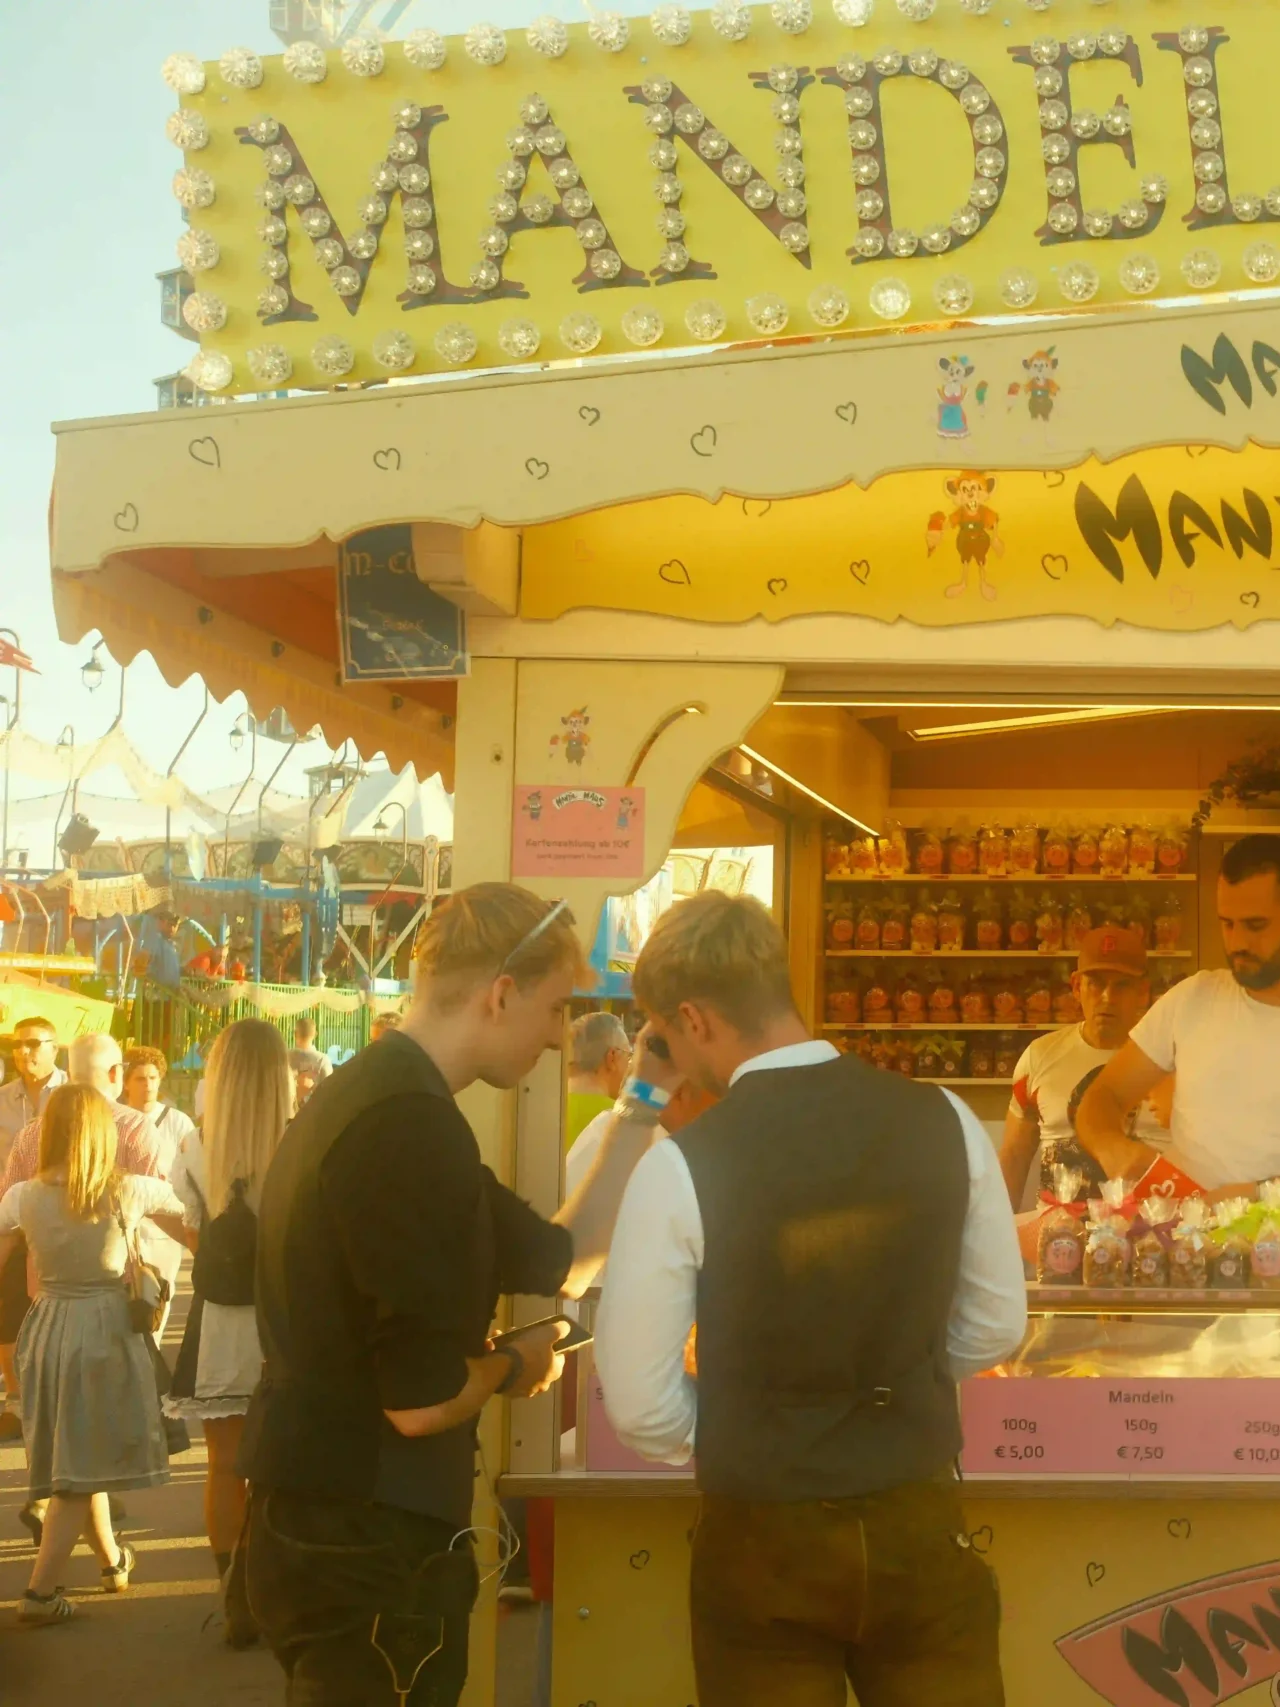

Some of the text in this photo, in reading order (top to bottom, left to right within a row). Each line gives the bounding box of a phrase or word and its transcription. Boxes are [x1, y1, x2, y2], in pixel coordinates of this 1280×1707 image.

[1108, 1390, 1174, 1404] Mandeln
[1001, 1418, 1280, 1437] 100g 150g 250g
[994, 1445, 1045, 1460] € 5,00
[1117, 1446, 1164, 1461] € 7,50
[1234, 1448, 1245, 1461] €
